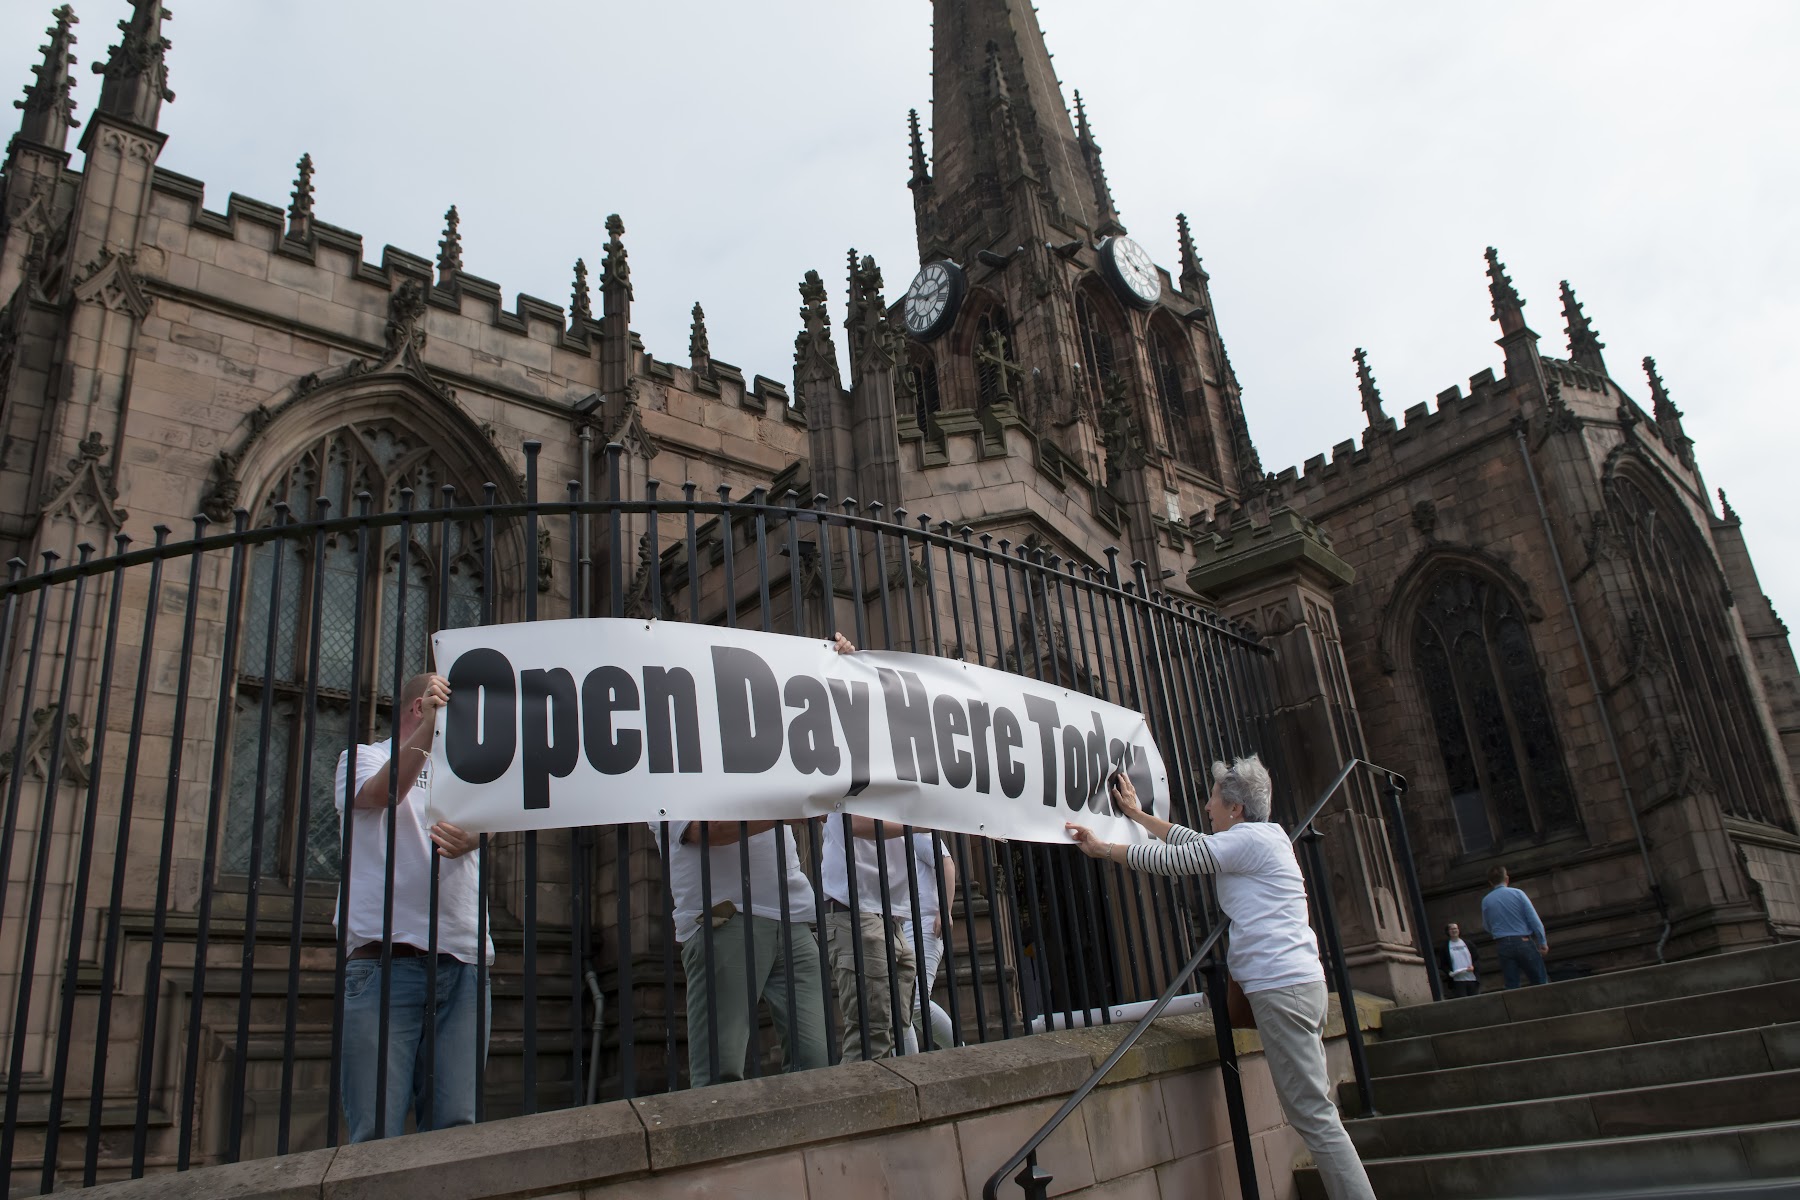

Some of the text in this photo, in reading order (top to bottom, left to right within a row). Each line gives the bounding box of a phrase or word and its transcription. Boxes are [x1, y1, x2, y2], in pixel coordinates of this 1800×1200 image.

[446, 647, 703, 810] Open
[711, 645, 870, 797] Day
[875, 666, 1026, 799] Here
